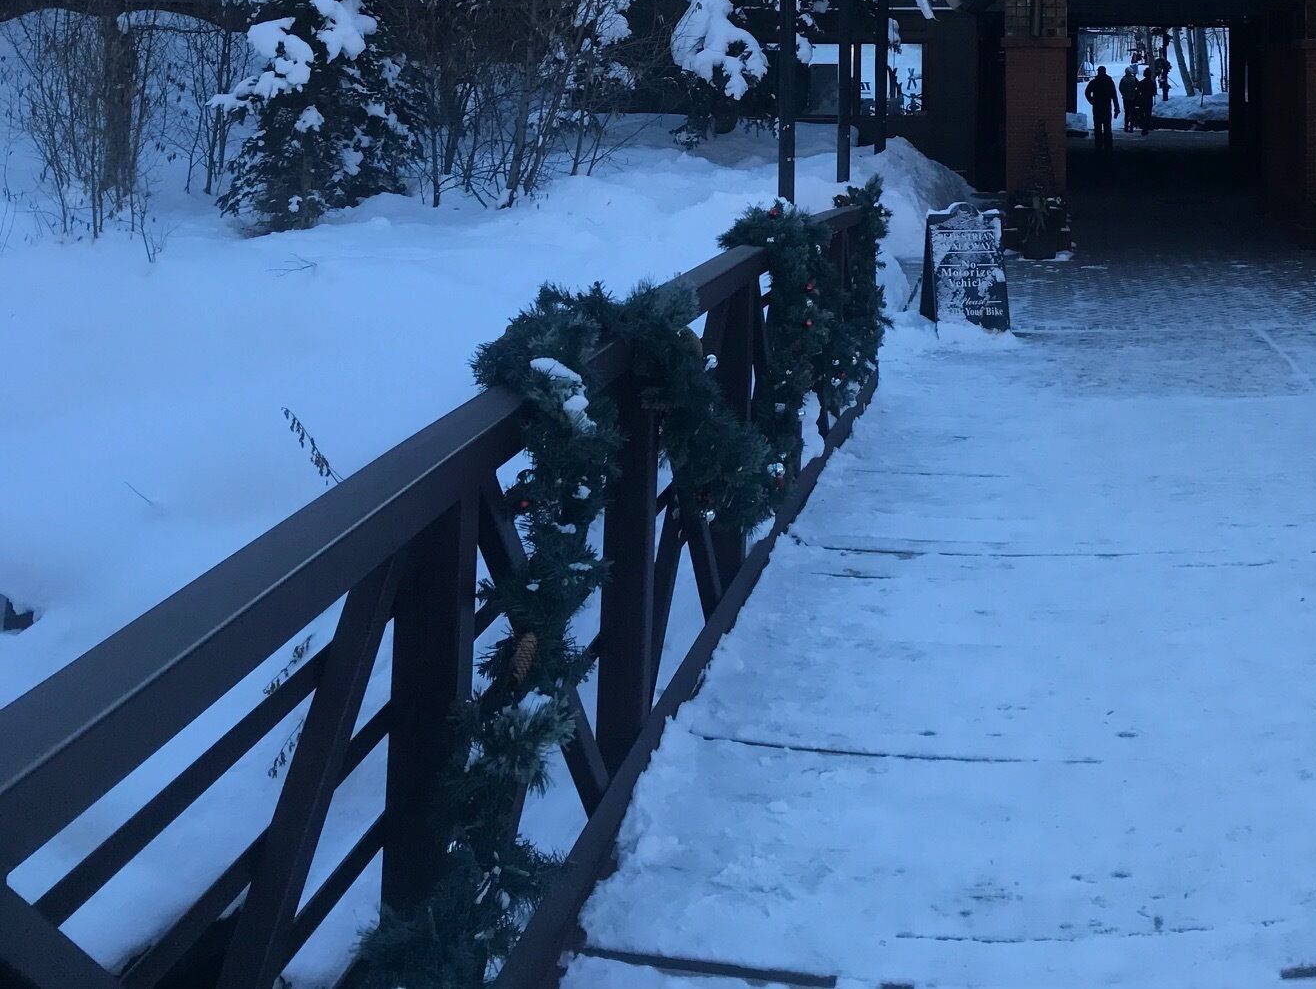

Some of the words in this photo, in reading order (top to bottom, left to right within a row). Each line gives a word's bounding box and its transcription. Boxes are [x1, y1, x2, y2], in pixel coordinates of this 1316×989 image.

[961, 260, 976, 269] No
[941, 267, 996, 277] Motorize
[949, 278, 993, 287] Vehicls
[986, 307, 1004, 316] Bike
